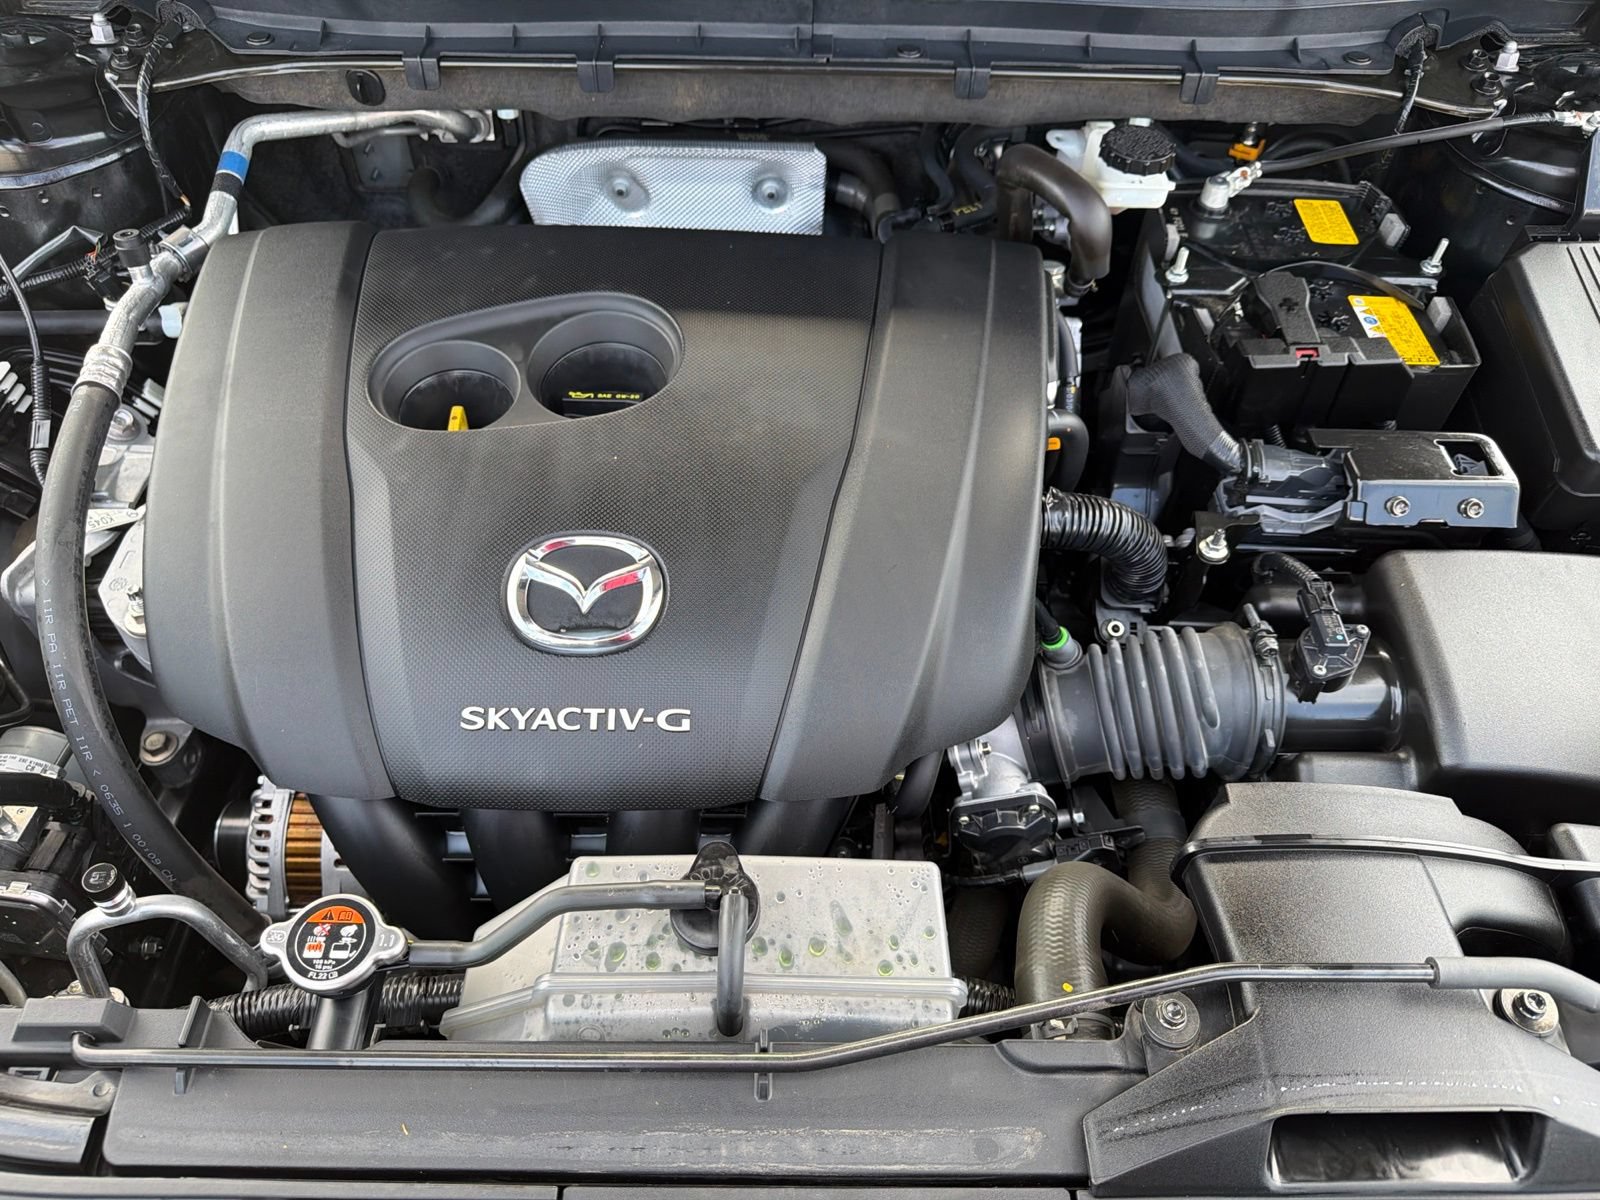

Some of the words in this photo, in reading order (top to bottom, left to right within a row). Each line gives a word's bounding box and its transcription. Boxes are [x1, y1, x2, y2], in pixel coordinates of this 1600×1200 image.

[48, 633, 58, 653] PA
[62, 698, 79, 726] PET
[460, 706, 691, 732] SKYACTIV-G
[307, 971, 328, 980] FL22
